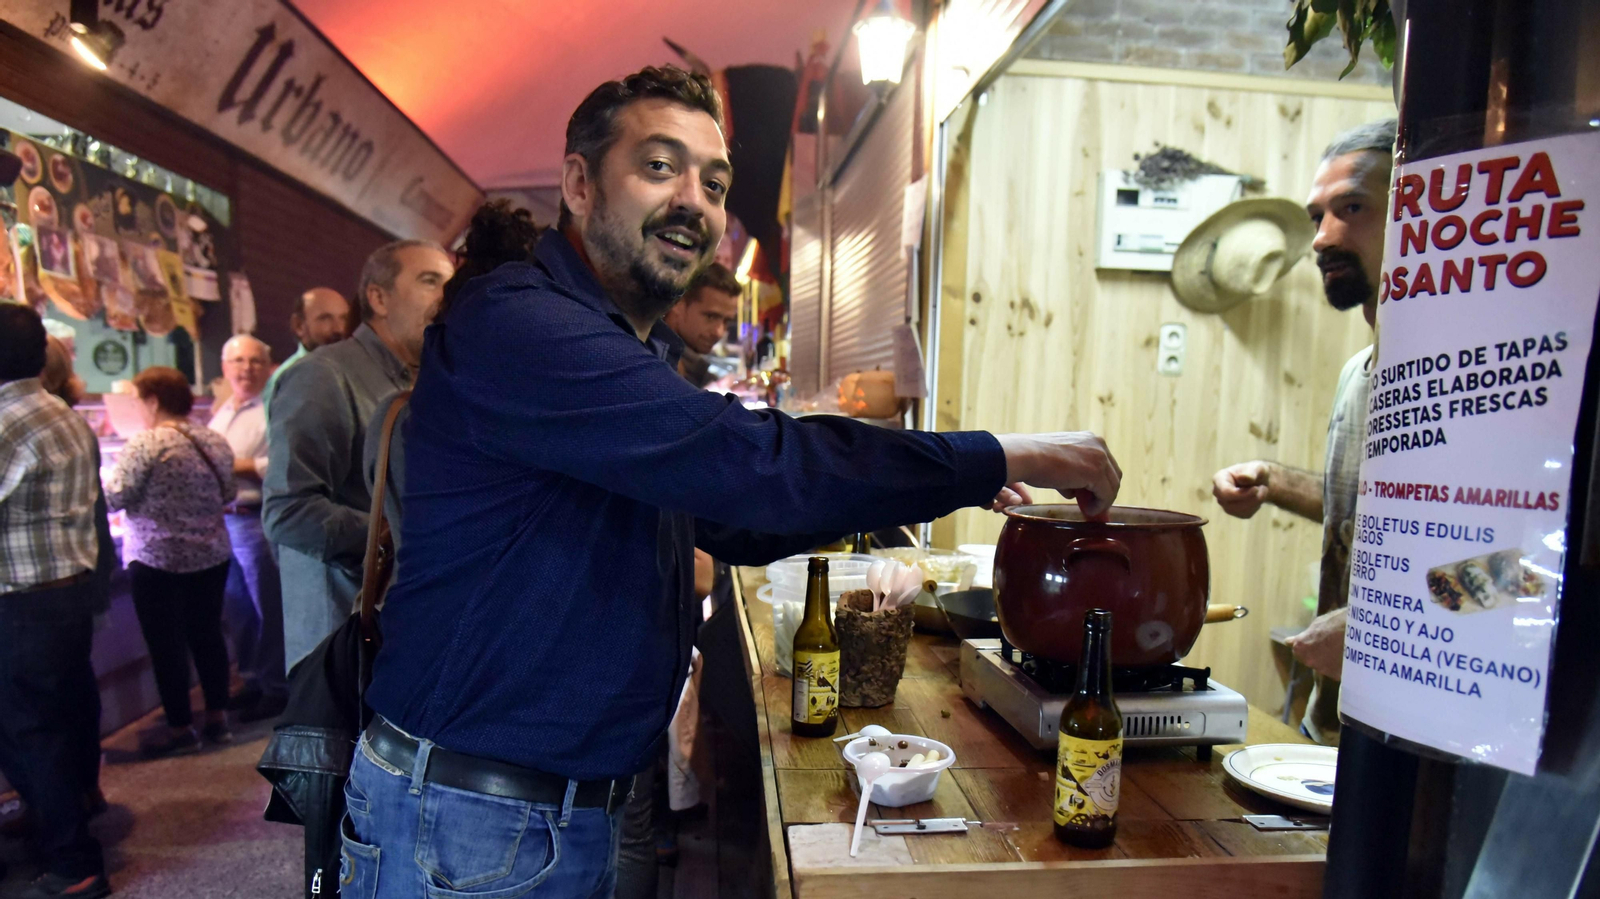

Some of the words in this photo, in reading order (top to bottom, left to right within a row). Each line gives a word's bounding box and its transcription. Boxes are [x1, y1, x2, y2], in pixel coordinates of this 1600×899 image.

[217, 21, 375, 181] Urbano
[1393, 152, 1560, 222] RUTA
[1400, 199, 1584, 258] NOCHE
[1381, 353, 1451, 387] SURTIDO
[1458, 346, 1487, 369] DE
[1495, 331, 1568, 362] TAPAS
[1428, 359, 1562, 398] ELABORADA
[1449, 386, 1548, 419] FRESCAS
[1374, 481, 1450, 503] TROMPETAS
[1454, 487, 1560, 512] AMARILLAS
[1362, 515, 1420, 535] BOLETUS
[1425, 522, 1494, 544] EDULIS
[1357, 550, 1410, 572] BOLETUS
[1362, 587, 1425, 614] TERNERA
[1351, 608, 1401, 632] NISCALO
[1405, 619, 1415, 634] Y
[1418, 623, 1454, 643] AJO
[1344, 644, 1387, 674] OMPETA
[1390, 662, 1482, 699] AMARILLA
[1364, 632, 1432, 663] CEBOLLA
[1437, 649, 1542, 689] (VEGANO)
